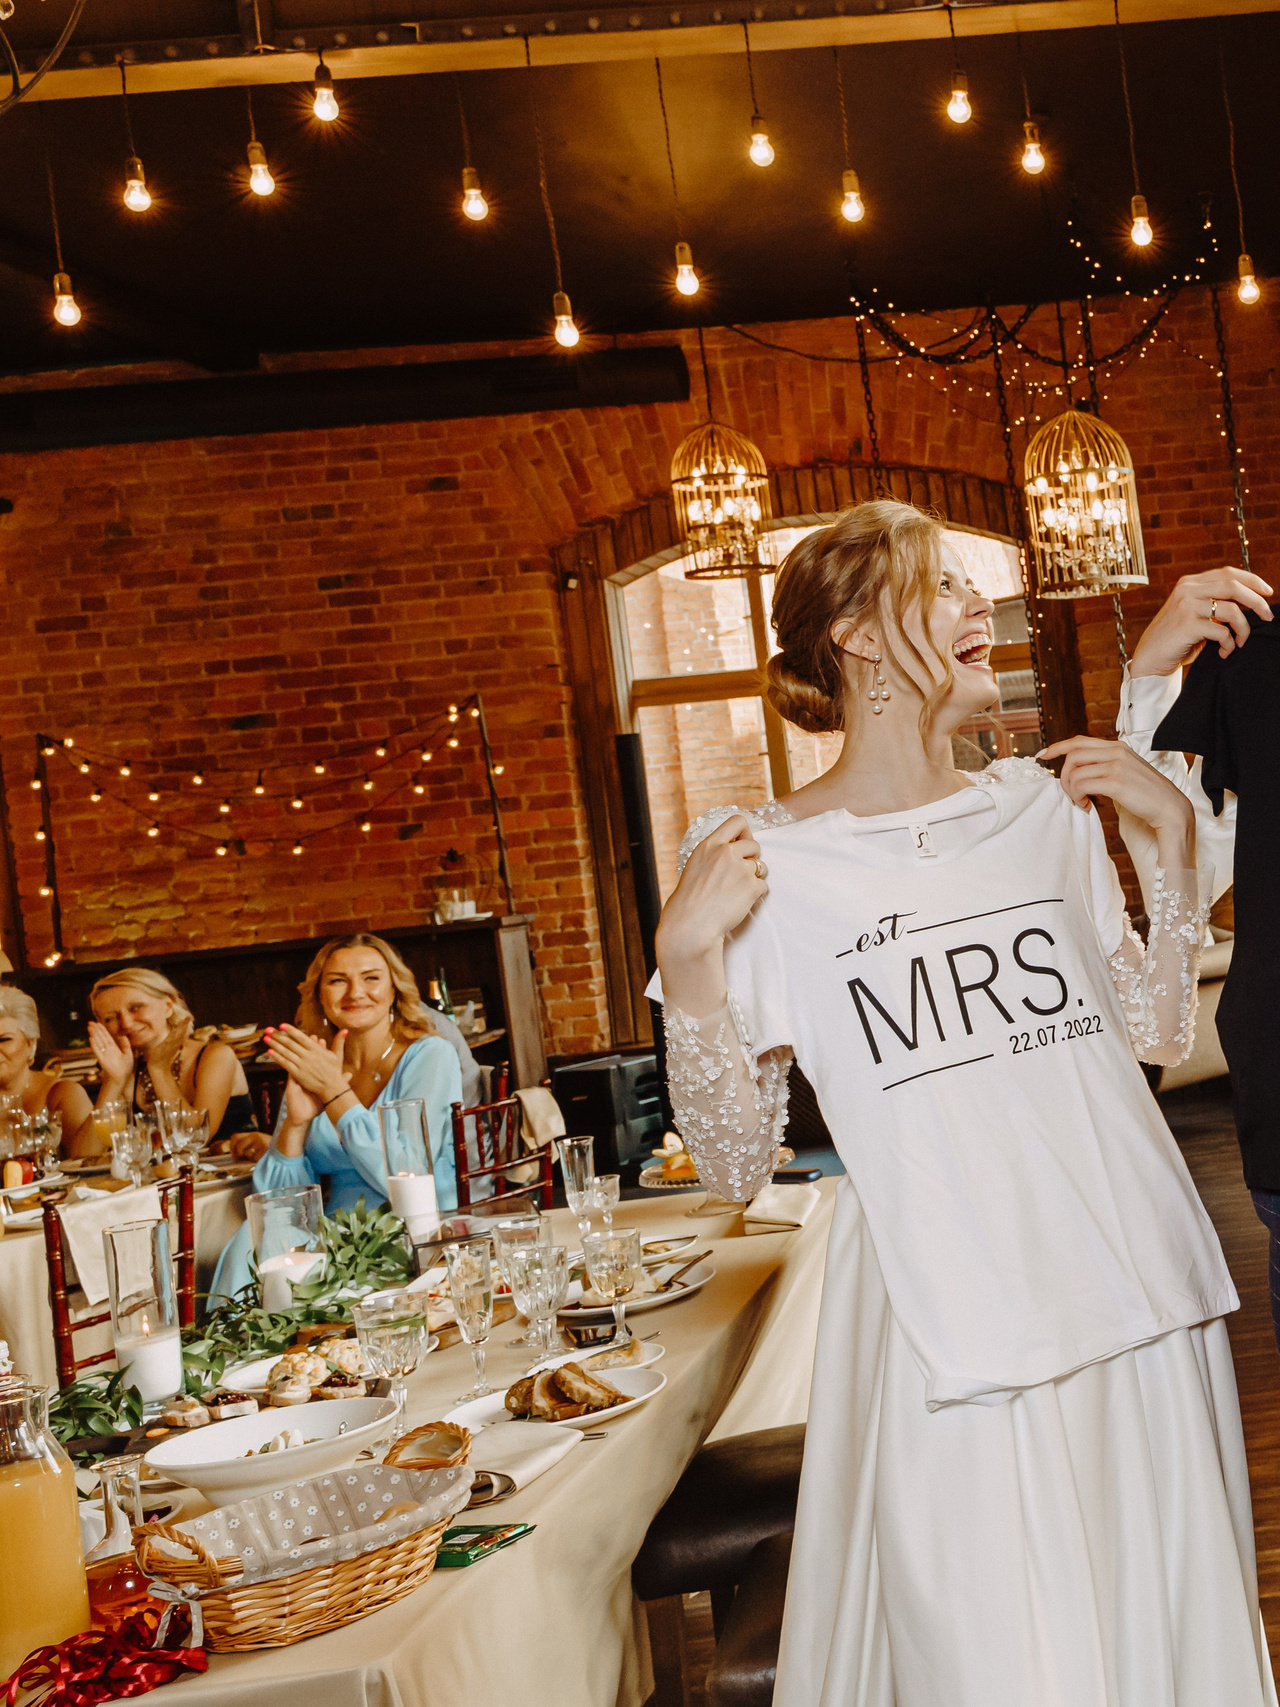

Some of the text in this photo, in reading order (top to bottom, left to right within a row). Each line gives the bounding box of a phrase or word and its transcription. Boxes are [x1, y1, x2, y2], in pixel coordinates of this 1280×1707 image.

[855, 910, 918, 953] est
[846, 927, 1084, 1065] MRS.
[1008, 1014, 1104, 1055] 22.07.2022
